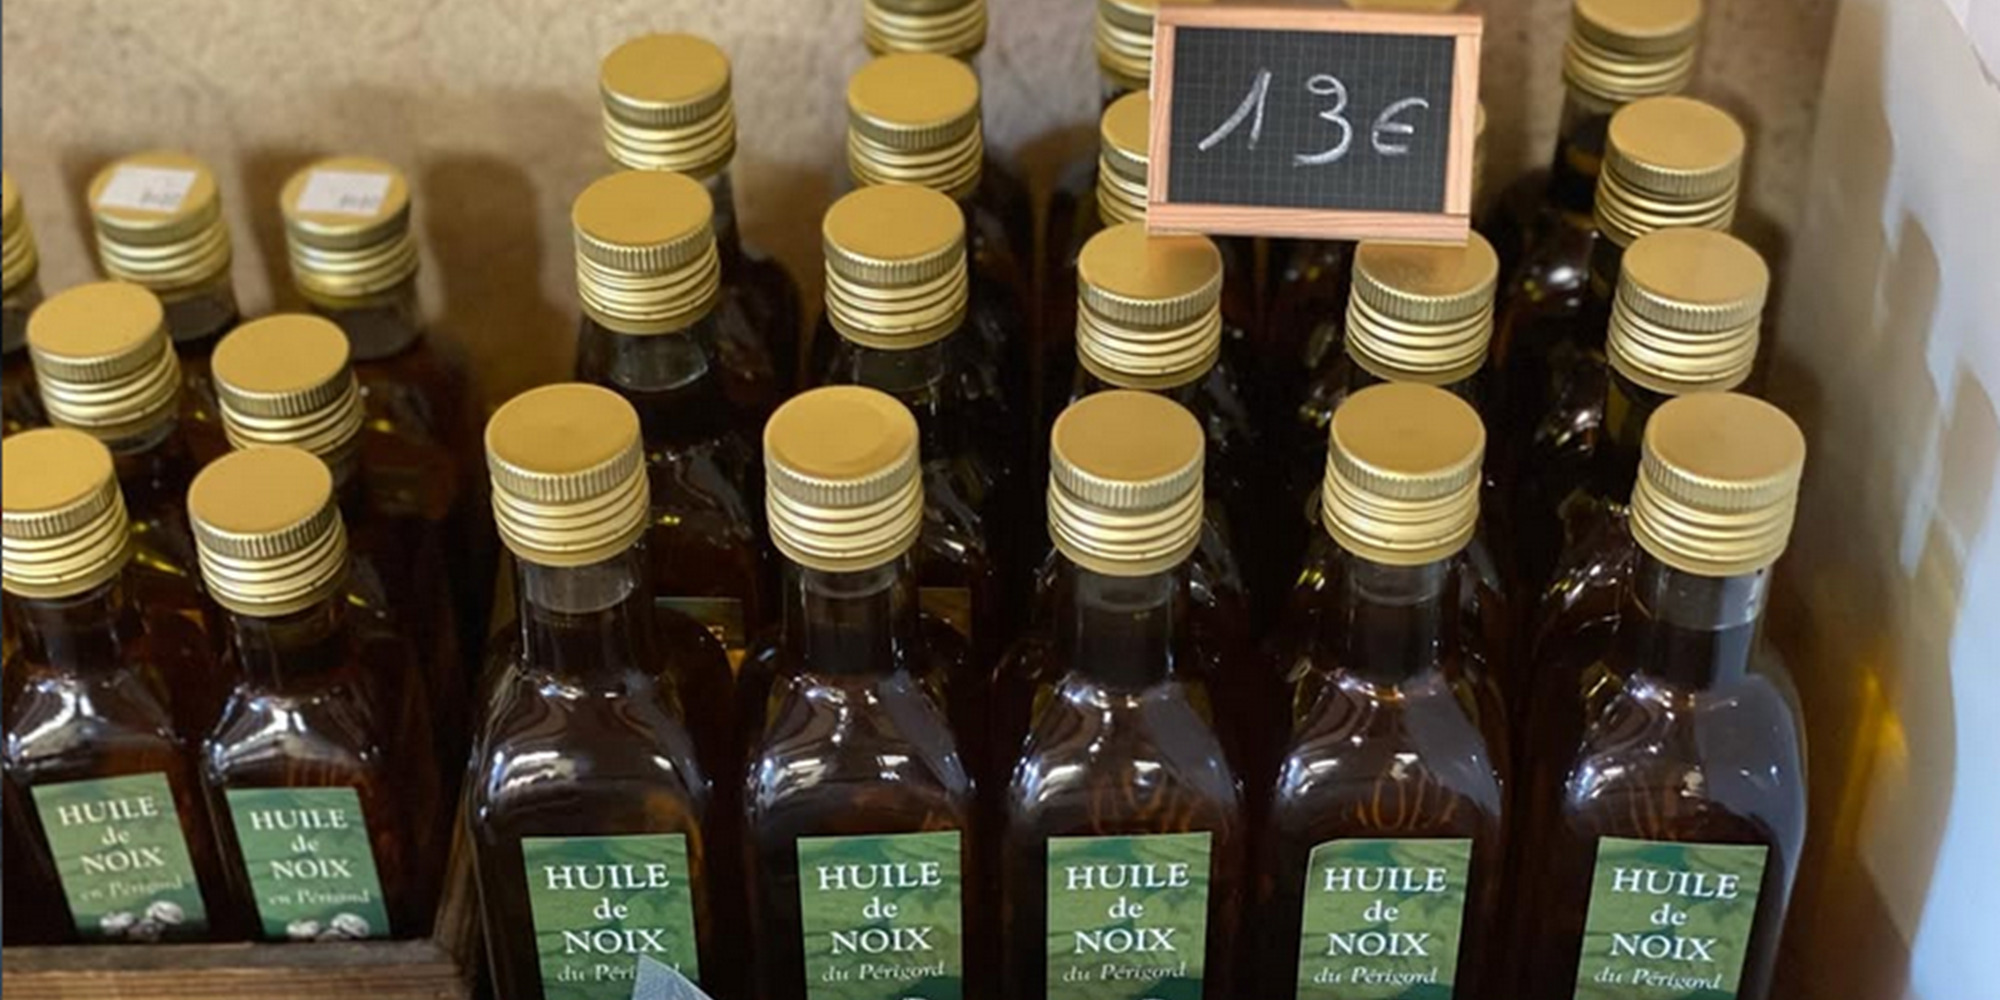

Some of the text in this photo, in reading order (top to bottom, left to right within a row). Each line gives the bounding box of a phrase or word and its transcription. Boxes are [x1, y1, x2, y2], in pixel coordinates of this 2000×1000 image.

[1198, 67, 1430, 167] 13€
[57, 796, 160, 827] HUILE
[249, 808, 349, 831] HUILE
[101, 825, 130, 846] de
[290, 833, 319, 853] de
[80, 846, 165, 876] NOIX
[270, 857, 353, 880] NOIX
[543, 863, 671, 890] HUILE
[816, 861, 943, 891] HUILE
[1064, 862, 1191, 891] HUILE
[1323, 866, 1448, 892] HUILE
[1611, 866, 1741, 900] HUILE
[592, 896, 629, 920] de
[861, 896, 899, 920] de
[1107, 896, 1145, 919] de
[1362, 898, 1400, 922] de
[1649, 902, 1688, 926] de
[561, 927, 668, 955] NOIX
[829, 926, 934, 955] NOIX
[1073, 927, 1177, 954] NOIX
[1326, 931, 1431, 957] NOIX
[1609, 932, 1718, 963] NOIX
[556, 964, 585, 982] du
[822, 960, 946, 982] du Périgord
[1062, 961, 1187, 983] du Périgord
[1314, 965, 1438, 986] du Périgord
[1594, 965, 1723, 991] du Périgord
